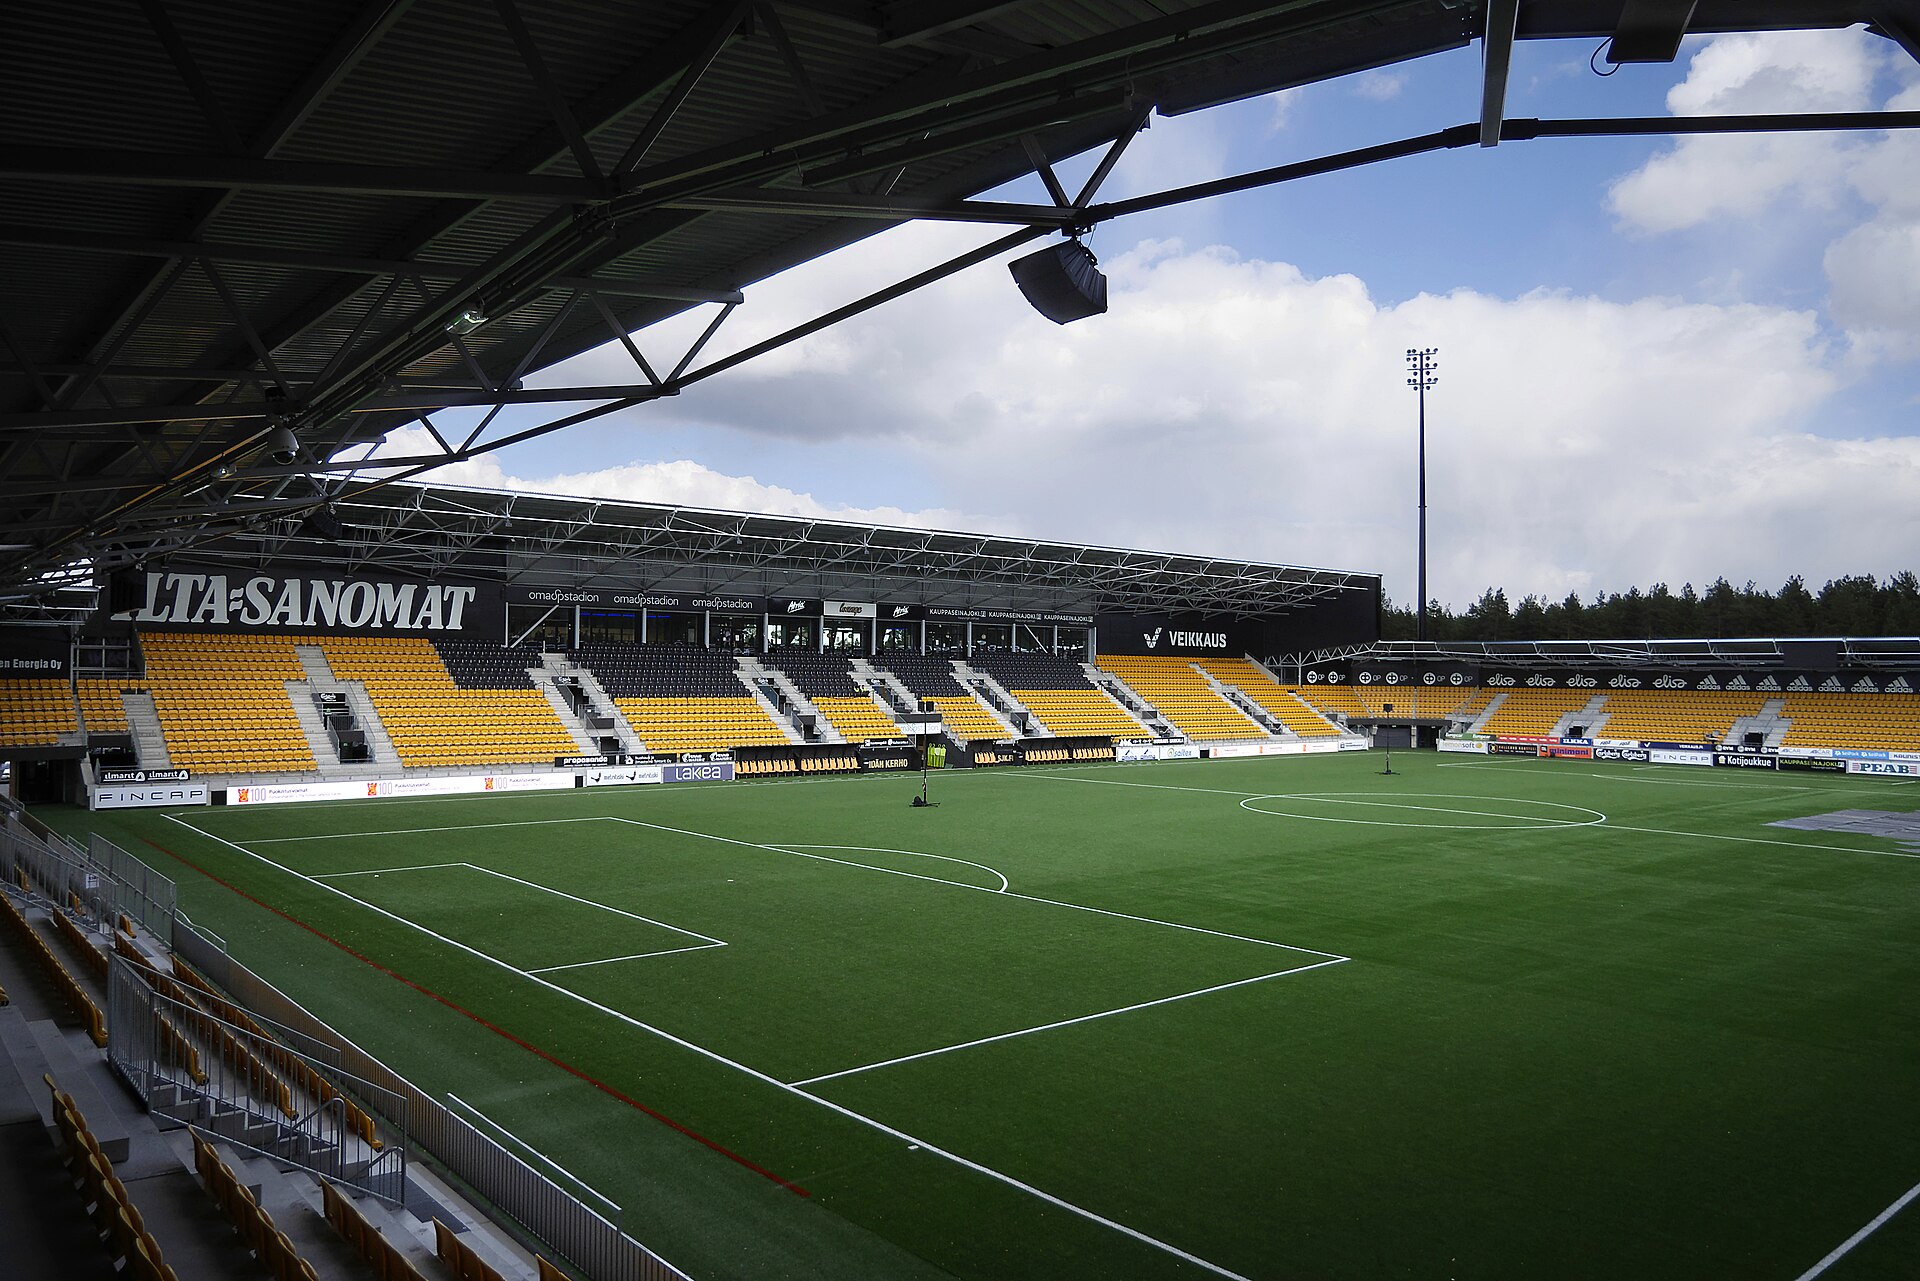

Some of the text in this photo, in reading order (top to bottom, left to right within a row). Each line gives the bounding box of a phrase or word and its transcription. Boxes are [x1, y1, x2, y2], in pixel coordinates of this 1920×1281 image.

[1169, 630, 1227, 648] VEIKKAUS
[13, 659, 48, 669] Energia
[50, 659, 62, 670] Oy
[1487, 673, 1516, 686] elisa
[1525, 673, 1556, 686] elisa
[1566, 673, 1598, 687] elisa
[1608, 674, 1641, 688] elisa
[1652, 674, 1687, 688] elisa
[1653, 753, 1709, 761] FINCAP
[1727, 756, 1772, 767] Kotijoukkue
[1860, 763, 1909, 773] PEAB
[250, 787, 267, 802] 100
[379, 782, 393, 796] 100
[100, 790, 203, 802] FINCAP
